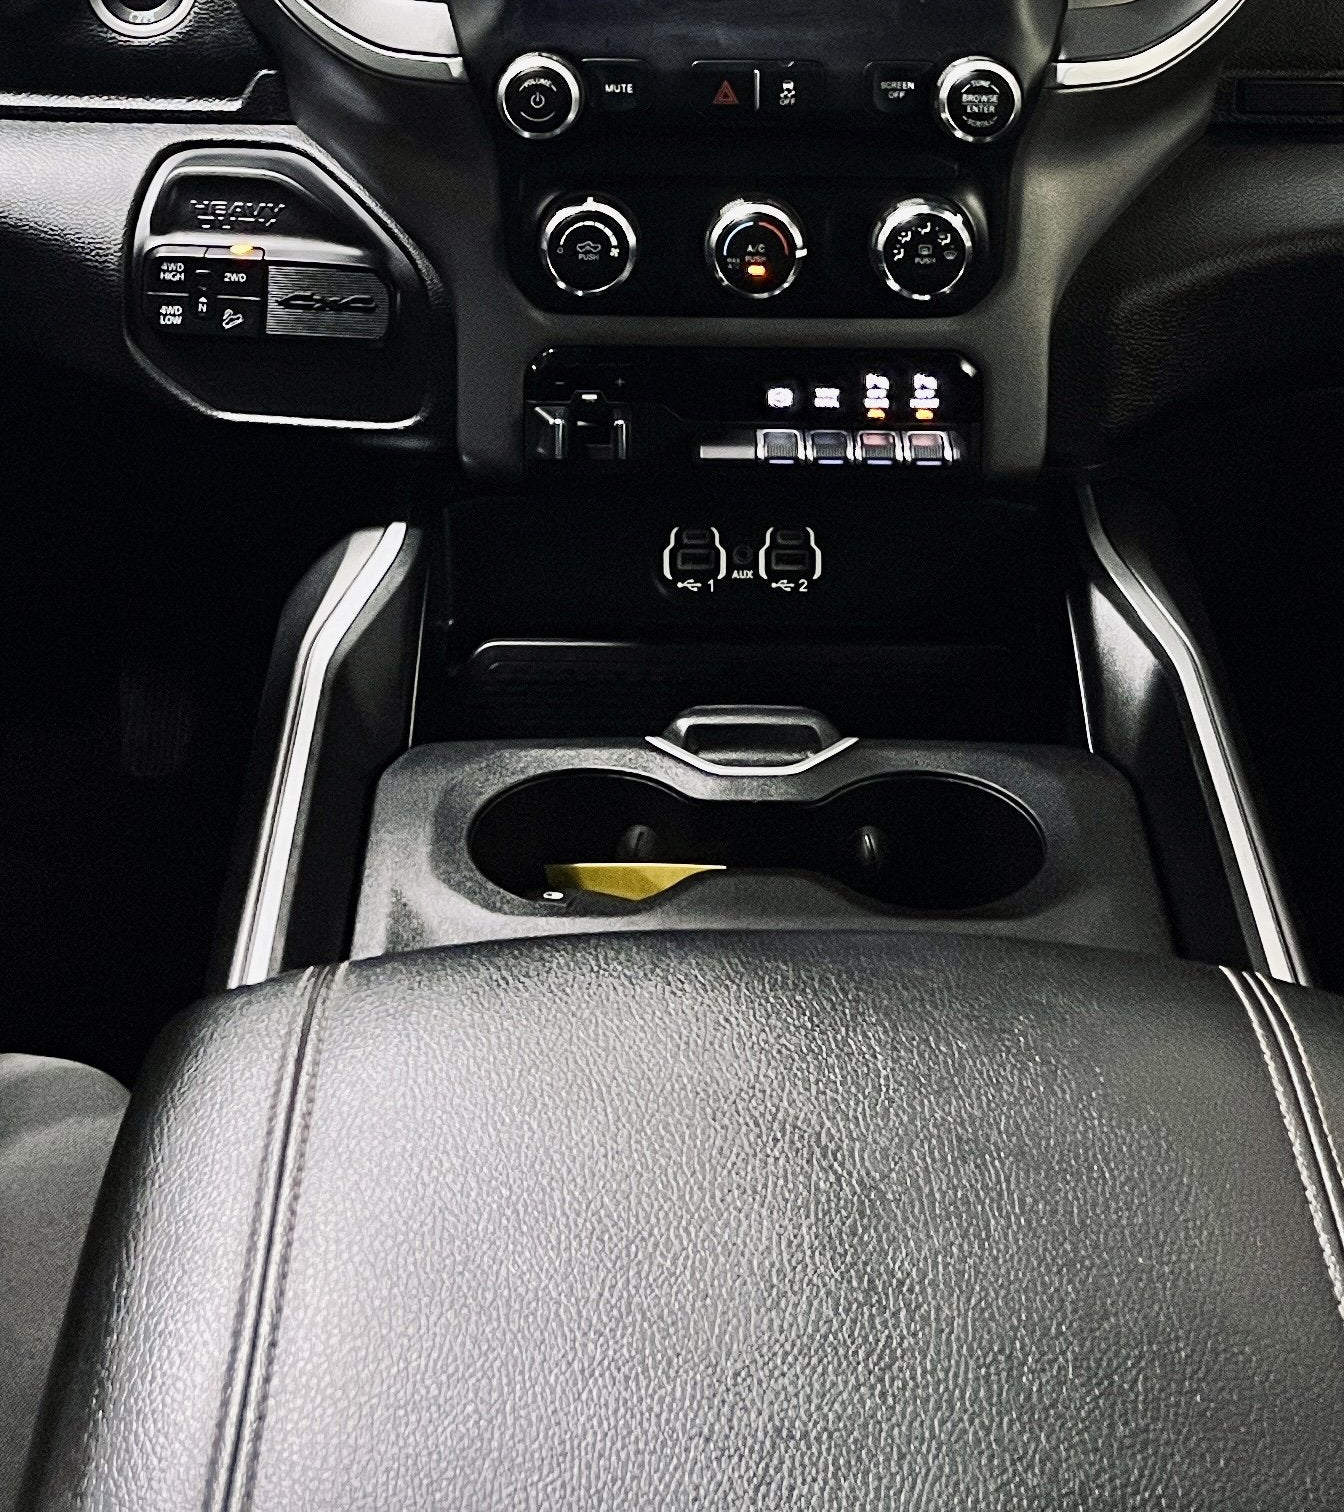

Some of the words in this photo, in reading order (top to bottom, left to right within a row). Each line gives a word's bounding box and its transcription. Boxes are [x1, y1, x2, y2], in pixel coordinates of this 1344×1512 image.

[605, 83, 634, 94] MUTE
[880, 81, 916, 91] SCREEN
[887, 90, 906, 100] OFF
[961, 93, 999, 104] BROWSE
[966, 104, 996, 114] ENTER
[746, 243, 767, 254] A/C
[578, 253, 600, 261] PUSH
[160, 262, 185, 272] 4WD
[159, 272, 185, 282] HIGH
[223, 272, 247, 283] 2WD
[159, 305, 183, 316] 4WD
[197, 304, 207, 313] N
[159, 314, 183, 325] LOW
[731, 569, 754, 579] AUX
[707, 579, 714, 593] 1
[798, 579, 809, 592] 2
